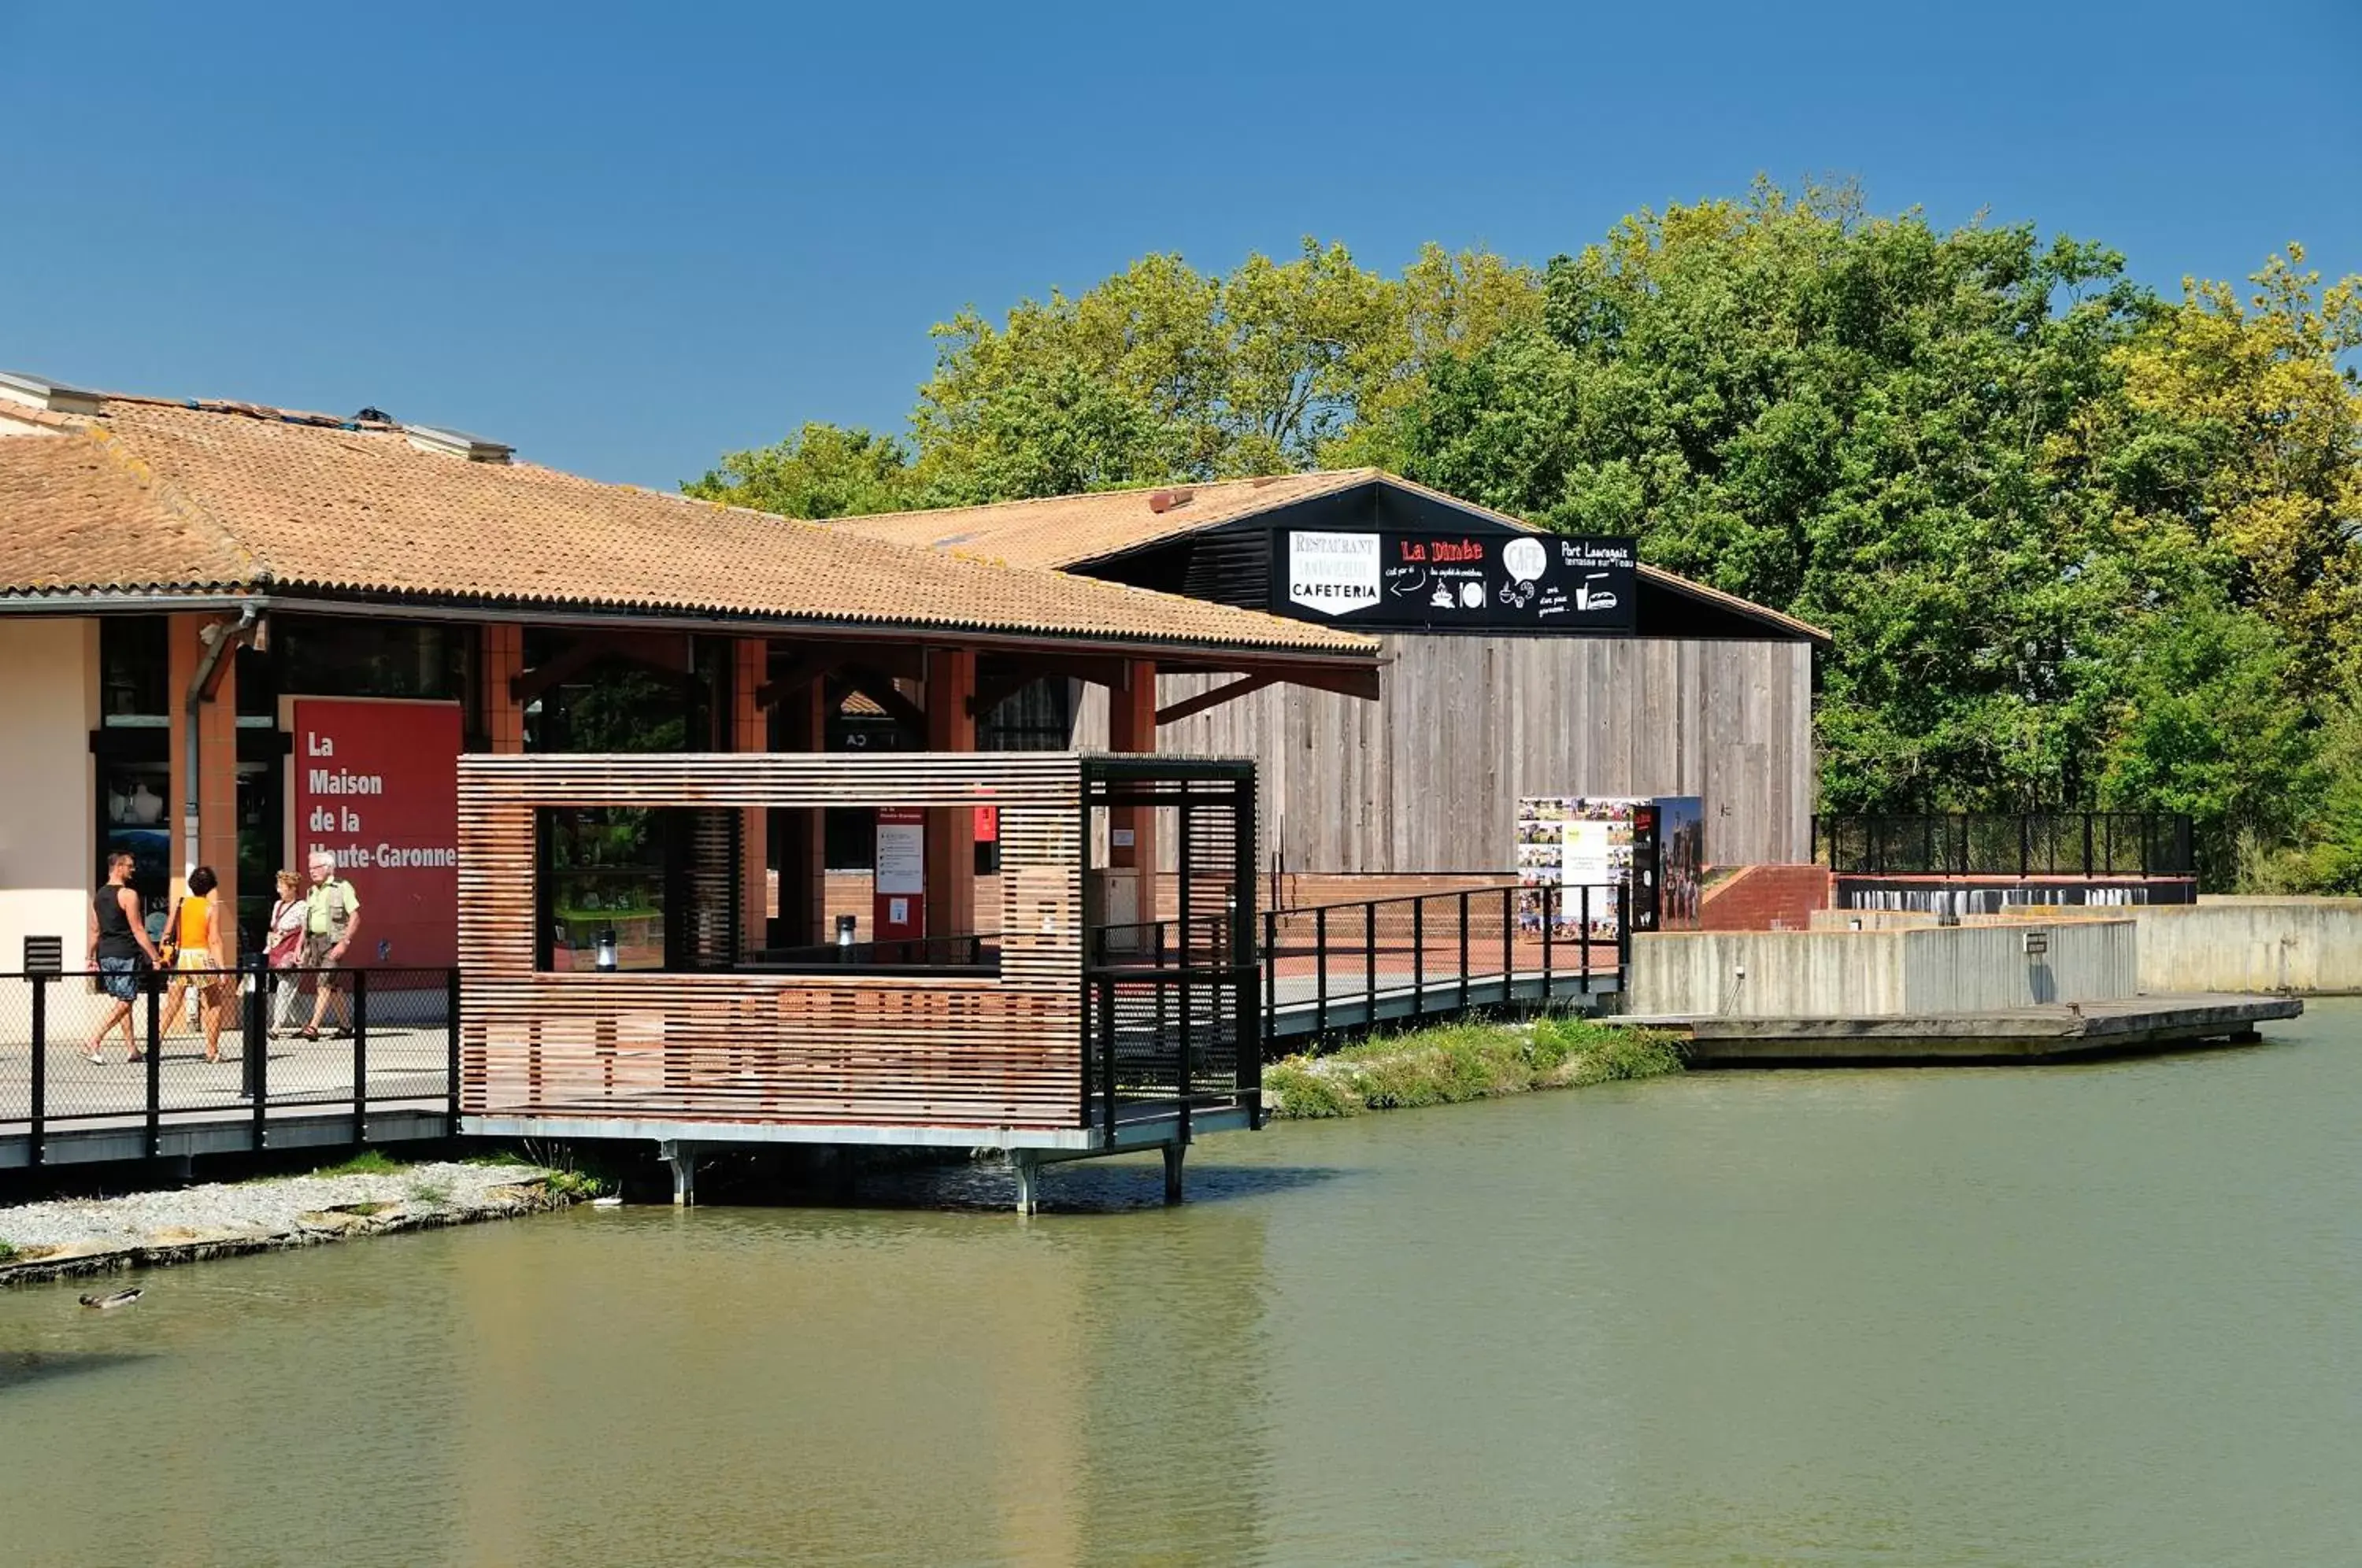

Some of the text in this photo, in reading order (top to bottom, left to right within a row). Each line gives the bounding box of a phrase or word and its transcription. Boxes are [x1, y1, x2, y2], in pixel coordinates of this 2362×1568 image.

[1401, 541, 1426, 561] La
[1561, 541, 1582, 557] Port
[1292, 582, 1377, 599] CAFETERIA
[308, 731, 334, 756] La
[309, 768, 383, 794] Maison
[309, 805, 361, 832] de la
